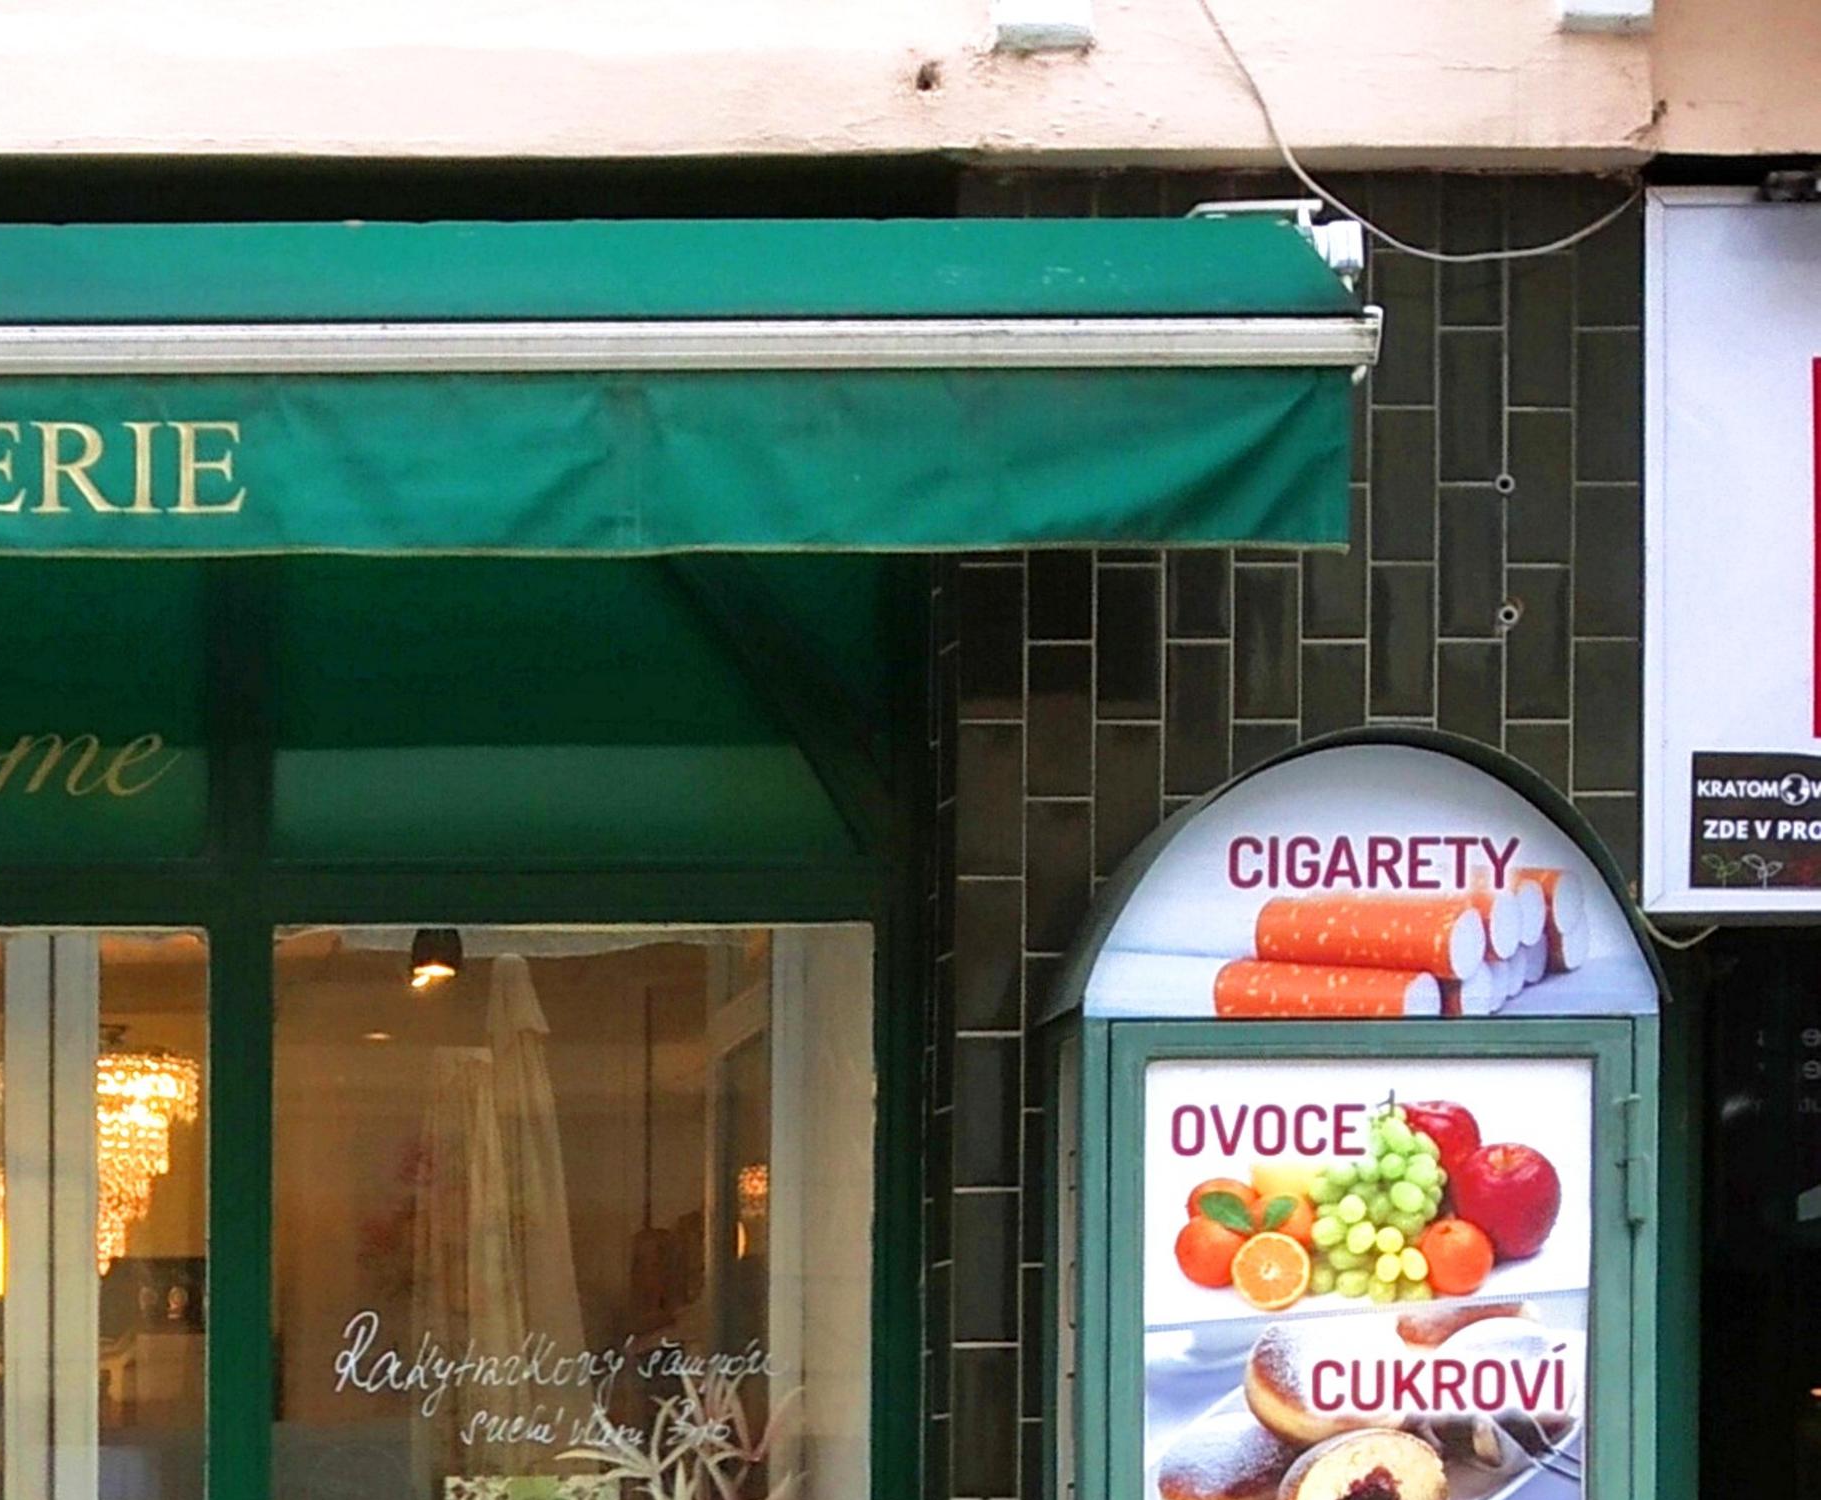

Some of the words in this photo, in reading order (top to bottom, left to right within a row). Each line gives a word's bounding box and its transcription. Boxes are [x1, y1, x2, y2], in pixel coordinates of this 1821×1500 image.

[1696, 779, 1778, 798] KRATOM
[1703, 819, 1748, 840] ZDE
[1754, 819, 1772, 840] V
[1228, 834, 1521, 892] CIGARETY
[1171, 1103, 1367, 1157] OVOCE
[1310, 1343, 1567, 1412] CUKROVÍ
